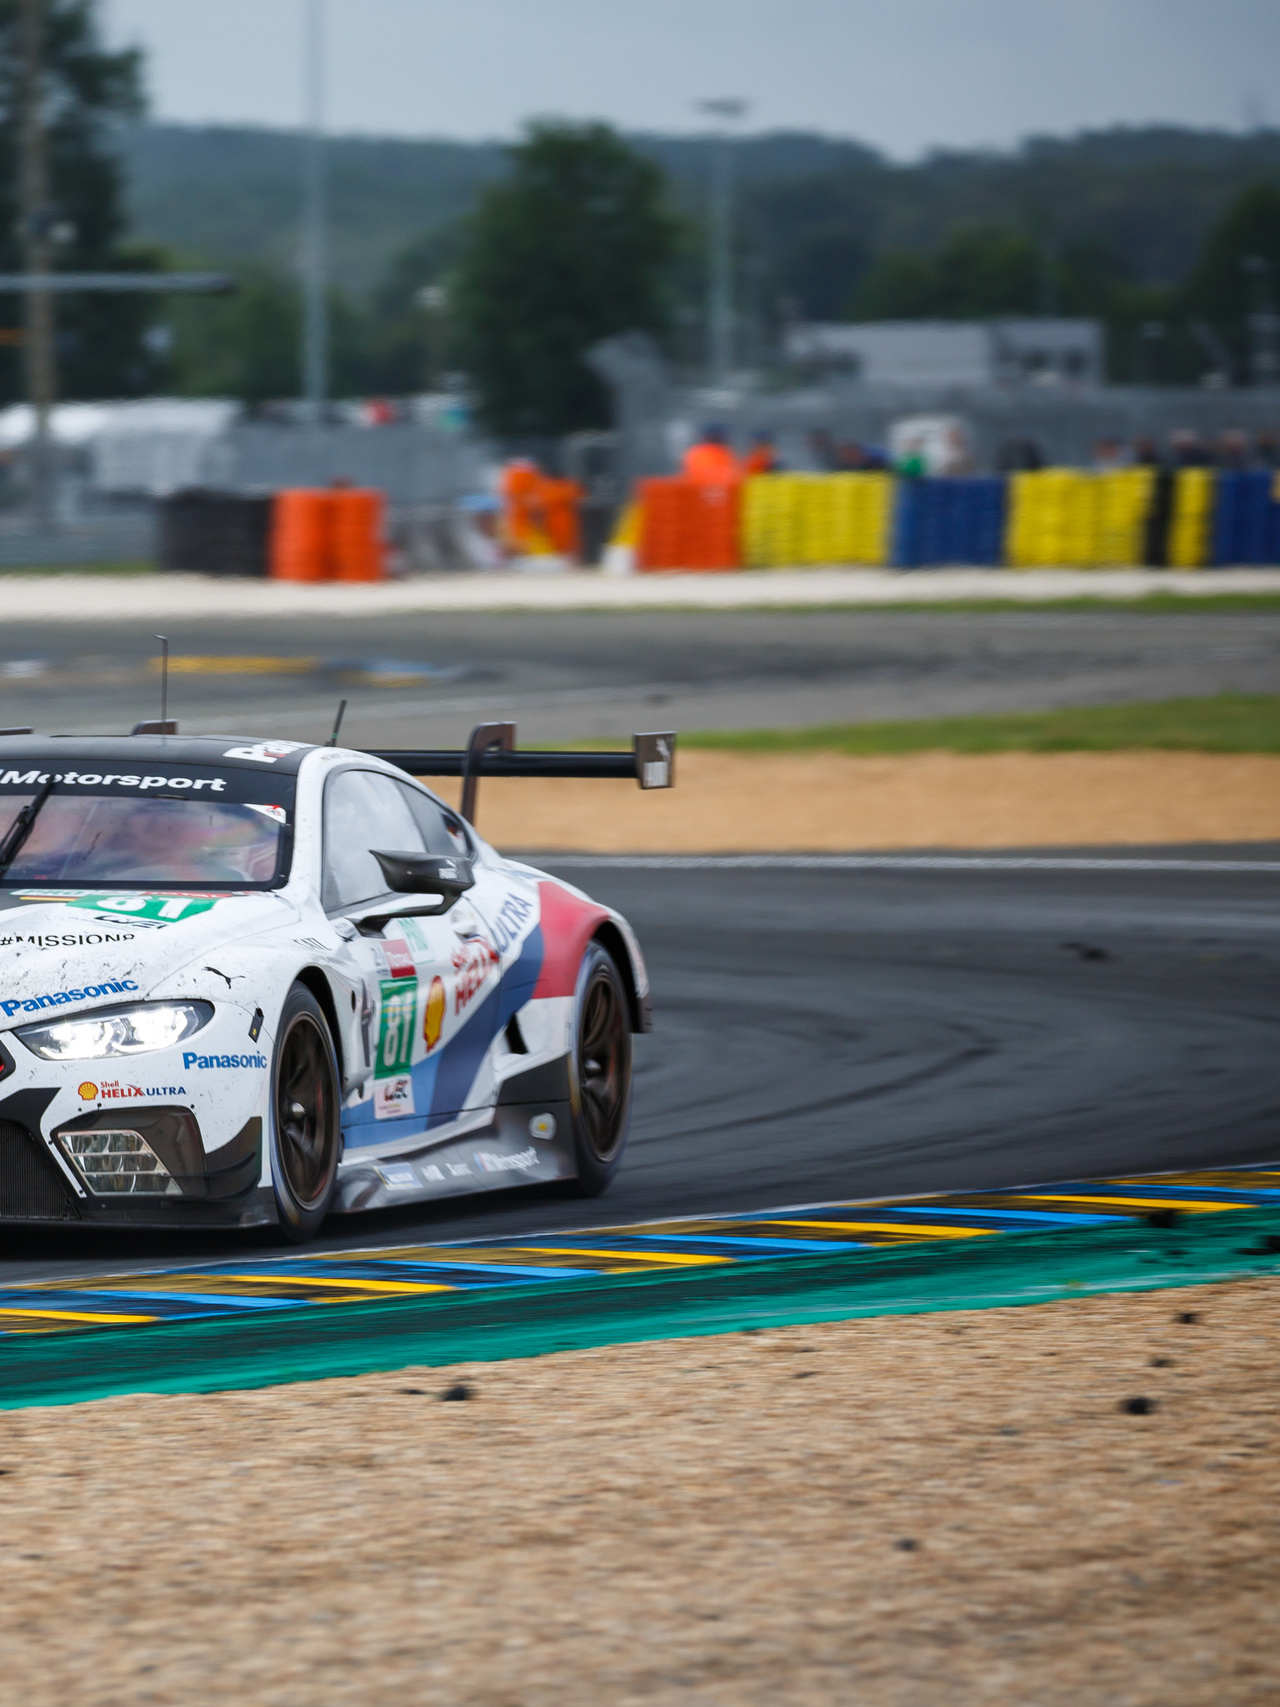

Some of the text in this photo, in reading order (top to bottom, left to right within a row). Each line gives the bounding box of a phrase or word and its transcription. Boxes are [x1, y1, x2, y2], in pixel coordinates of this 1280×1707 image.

[0, 770, 227, 791] Motorsport
[489, 892, 534, 954] ULTRA
[0, 978, 139, 1017] Panasonic
[383, 991, 414, 1067] 81
[182, 1051, 268, 1069] Panasonic
[100, 1080, 120, 1088] Shell
[101, 1084, 187, 1098] HELIX ULTRA
